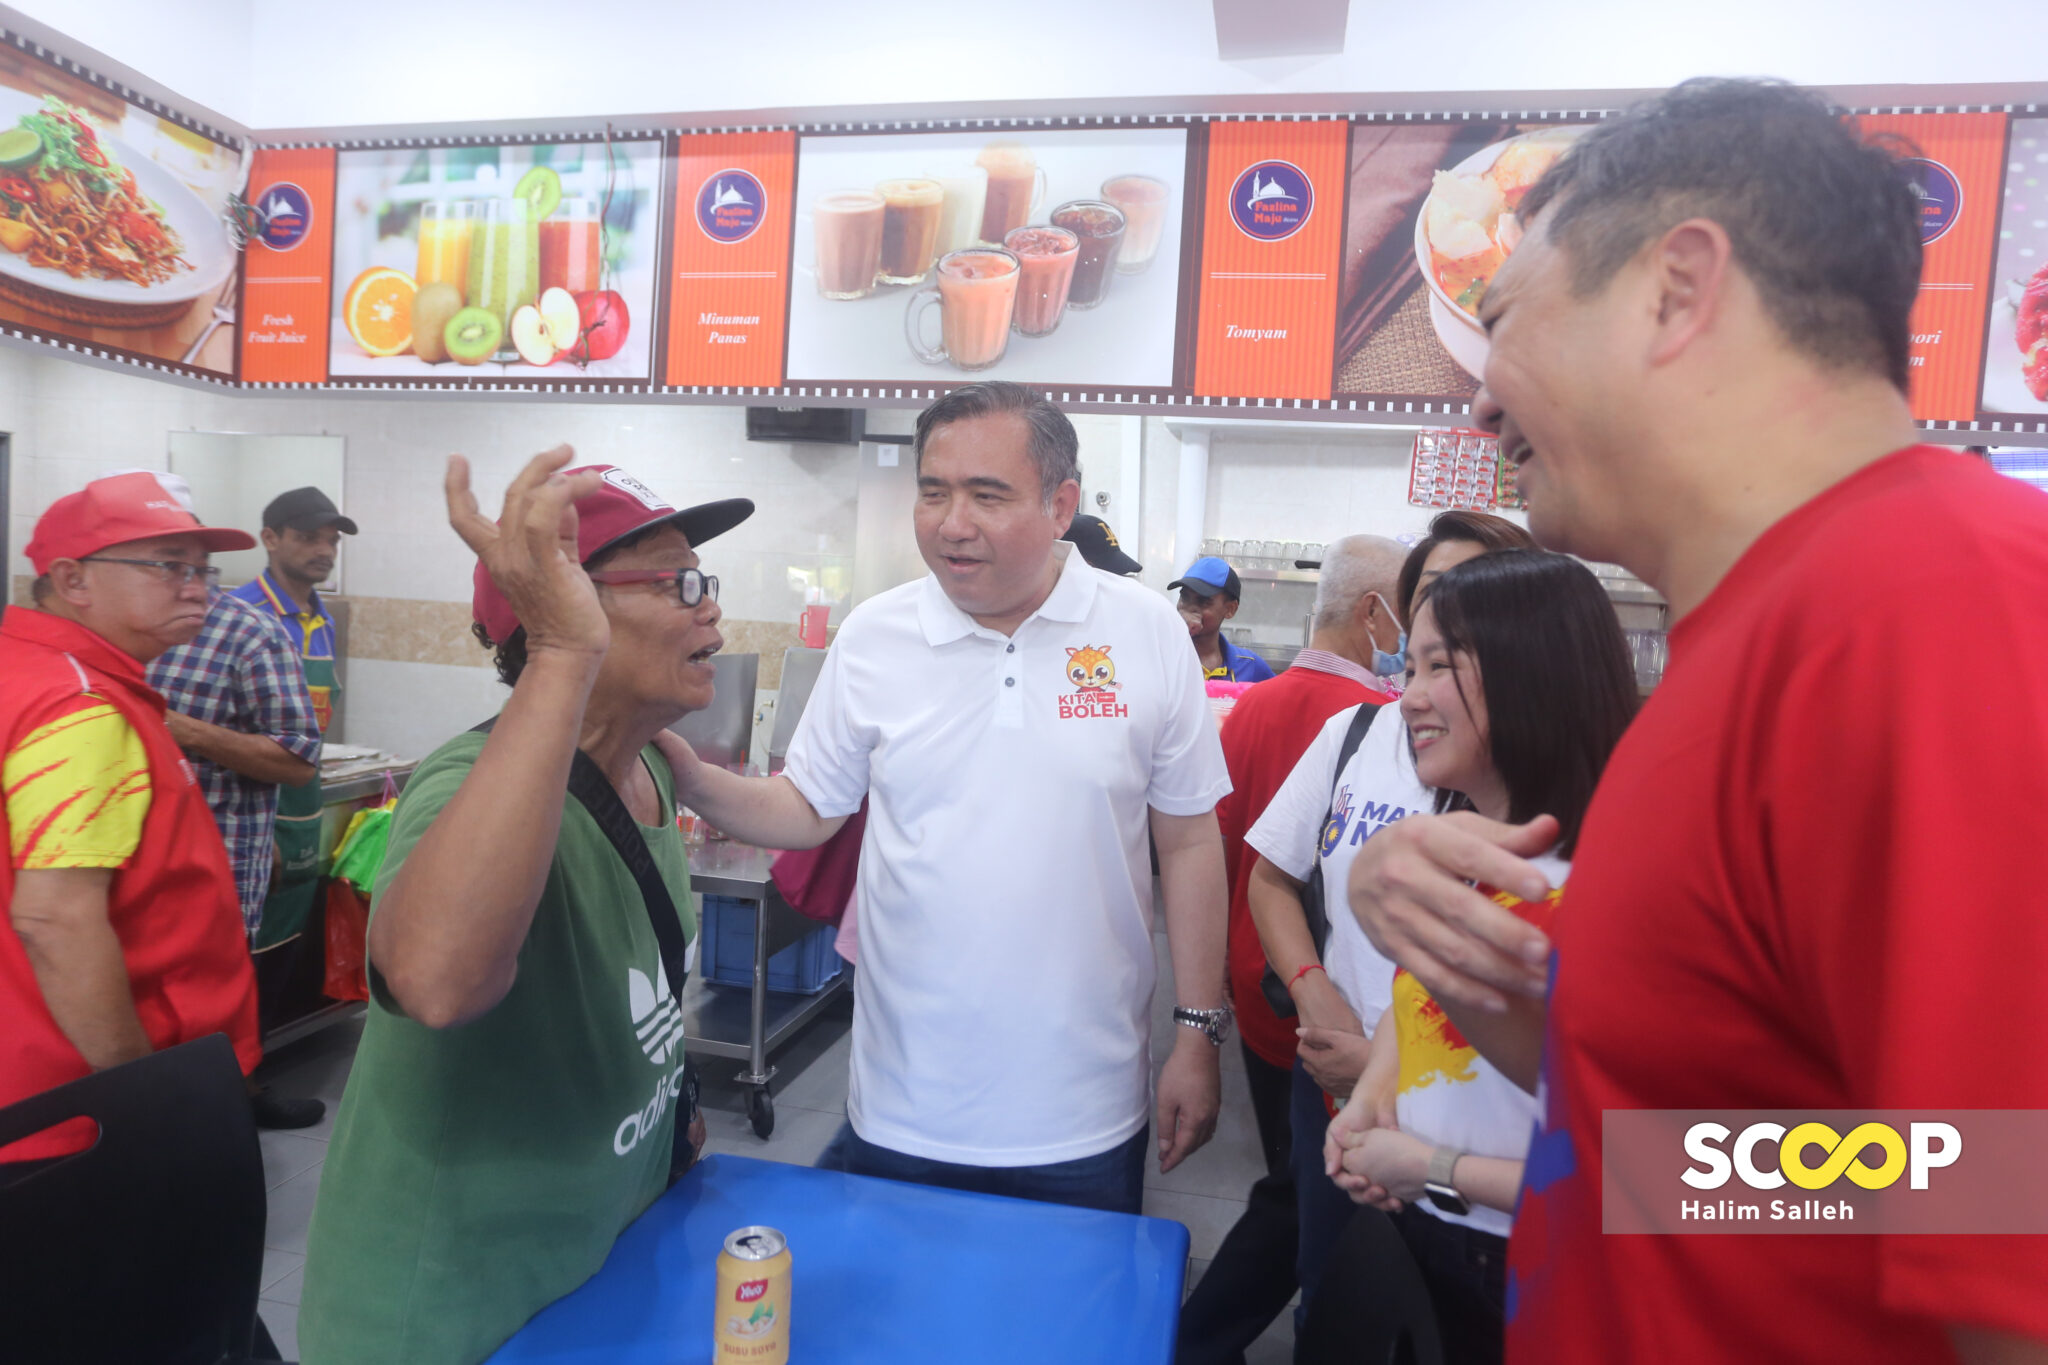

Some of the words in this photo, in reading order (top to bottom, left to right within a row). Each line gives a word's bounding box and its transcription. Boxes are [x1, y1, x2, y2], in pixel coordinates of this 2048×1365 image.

[1254, 213, 1283, 226] Maju
[262, 313, 294, 326] Fresh
[698, 312, 760, 325] Minuman
[248, 331, 276, 343] Fruit
[277, 331, 307, 343] Juice
[708, 331, 747, 344] Panas
[1226, 324, 1287, 342] Tomyam
[1058, 692, 1096, 705] KITA
[1059, 703, 1128, 719] BOLEH
[724, 1342, 749, 1356] SUSU
